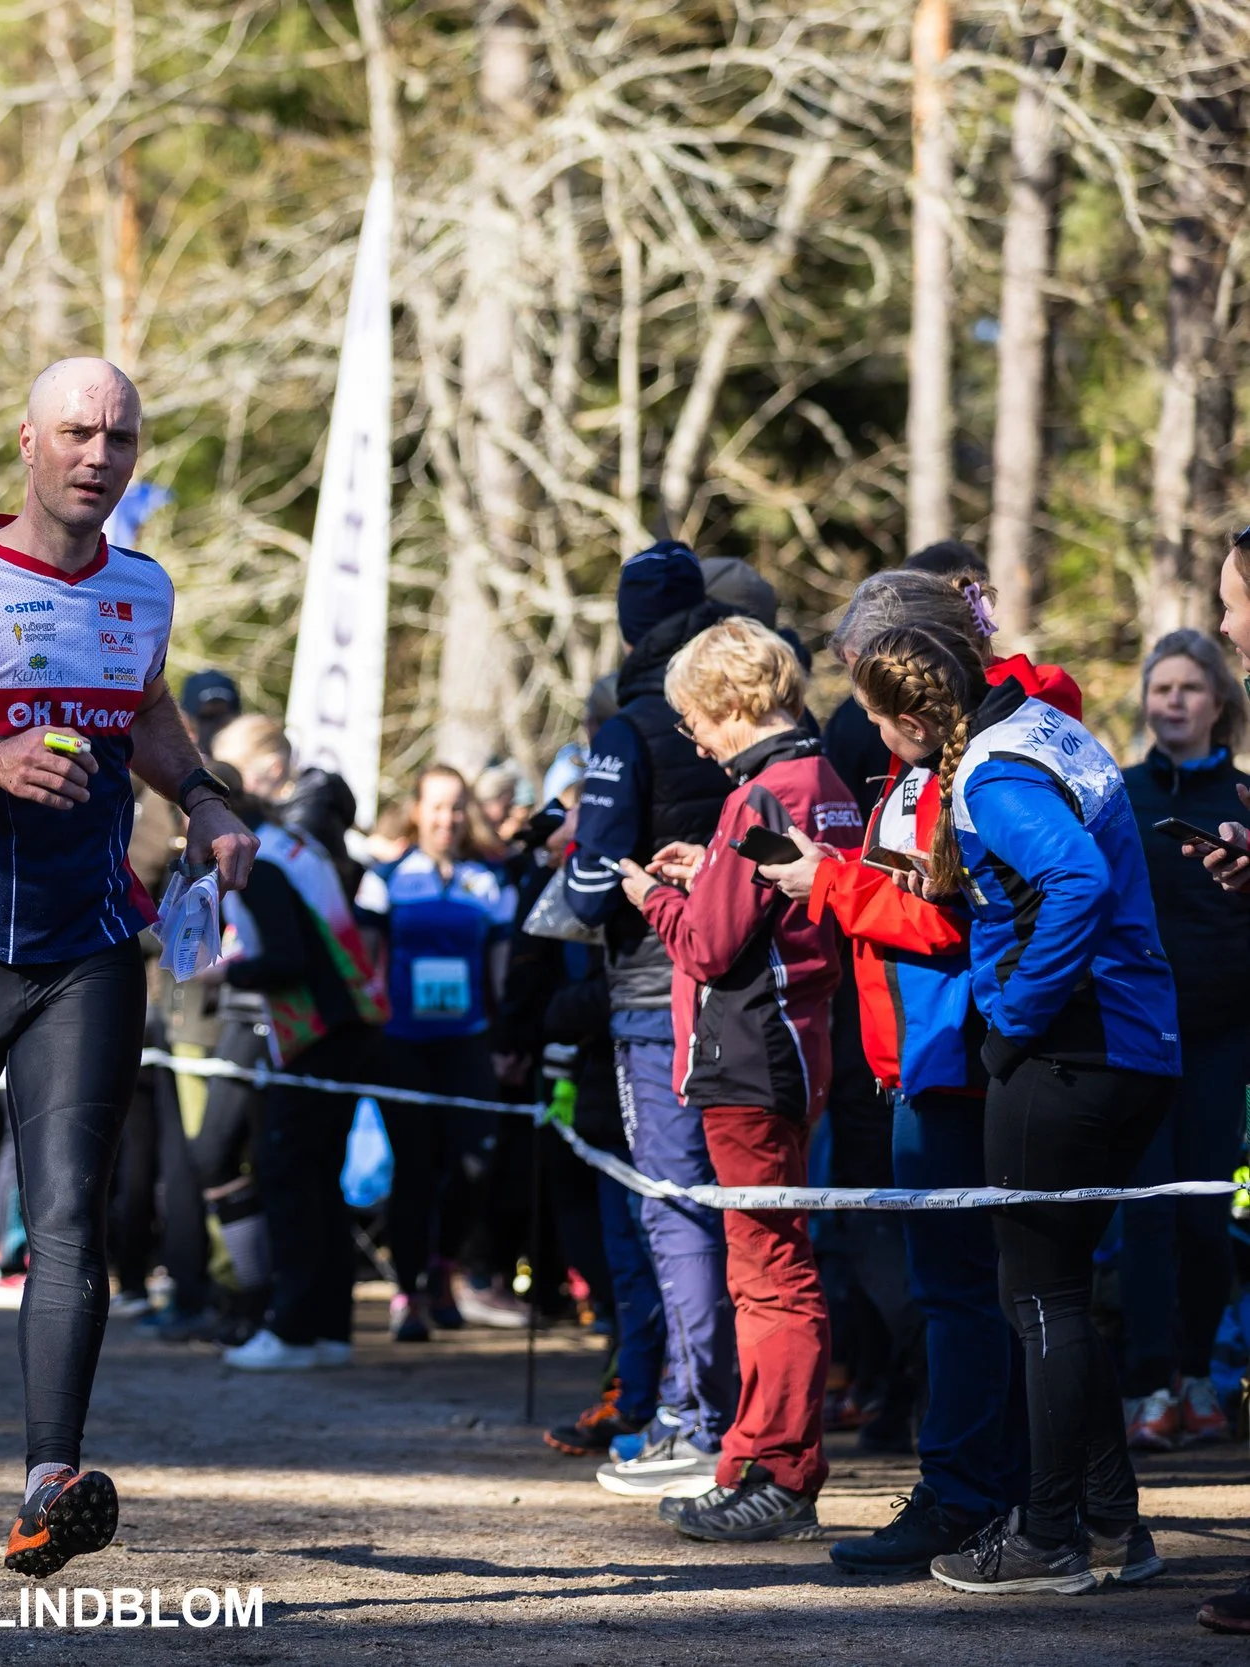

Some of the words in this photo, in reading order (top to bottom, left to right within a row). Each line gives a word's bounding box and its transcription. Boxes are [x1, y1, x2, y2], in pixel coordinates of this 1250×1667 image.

[15, 601, 54, 613] STENA
[98, 601, 115, 613] ICA
[101, 633, 118, 645] ICA
[12, 669, 63, 682] KUMLA
[7, 701, 52, 728] OK
[1061, 730, 1083, 756] OK
